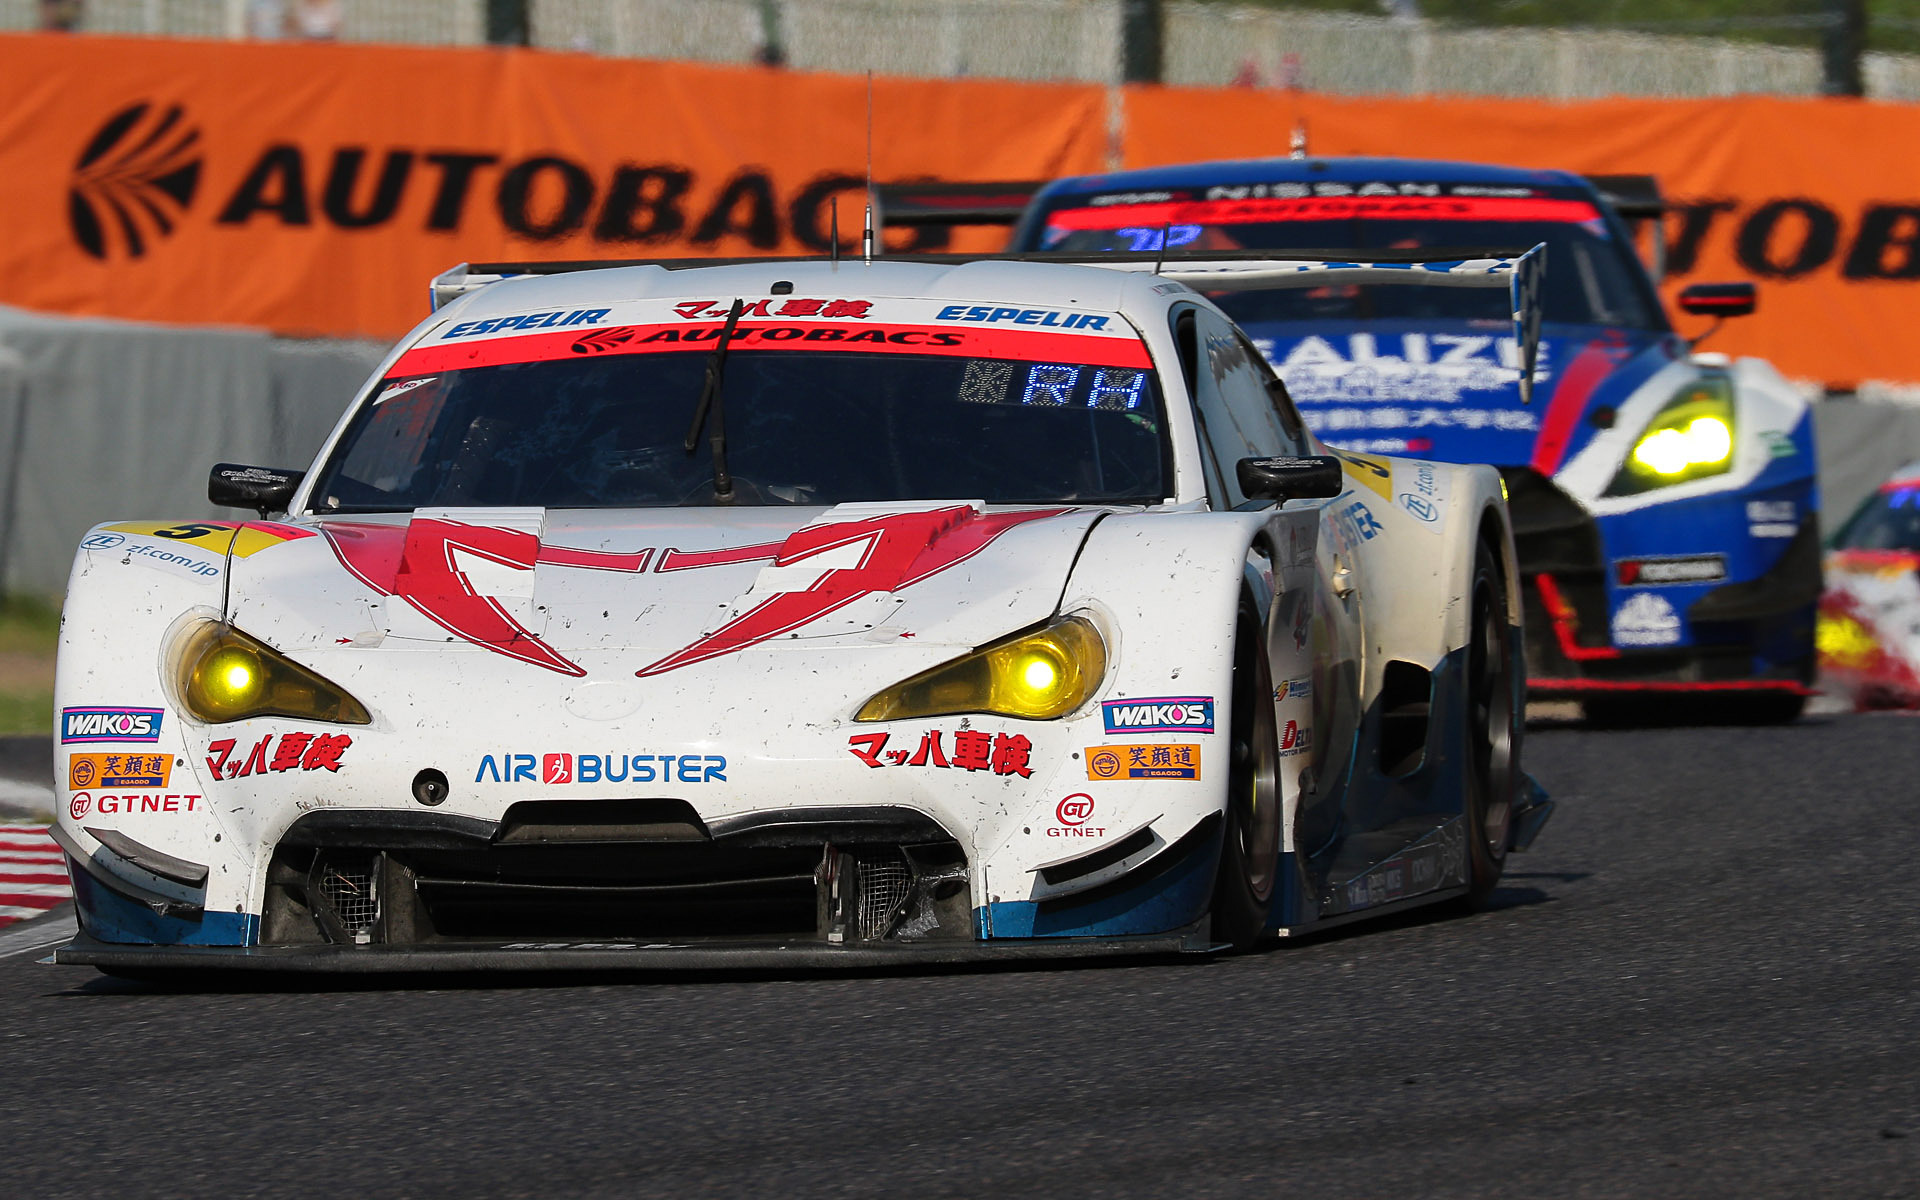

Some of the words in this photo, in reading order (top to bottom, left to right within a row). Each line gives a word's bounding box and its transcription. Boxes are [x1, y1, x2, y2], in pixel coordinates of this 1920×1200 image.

[440, 308, 612, 339] ESPELIR
[936, 305, 1110, 331] ESPELIR
[635, 327, 965, 346] AUTOBACS
[153, 523, 232, 539] 5
[84, 534, 120, 549] ZF
[125, 544, 219, 577] zf.com/jp
[103, 756, 165, 776] 笑顔道
[1128, 746, 1196, 768] 笑顔道
[475, 754, 537, 783] AIR
[577, 755, 728, 783] BUSTER
[97, 794, 202, 813] GTNET
[1046, 827, 1106, 837] GTNET
